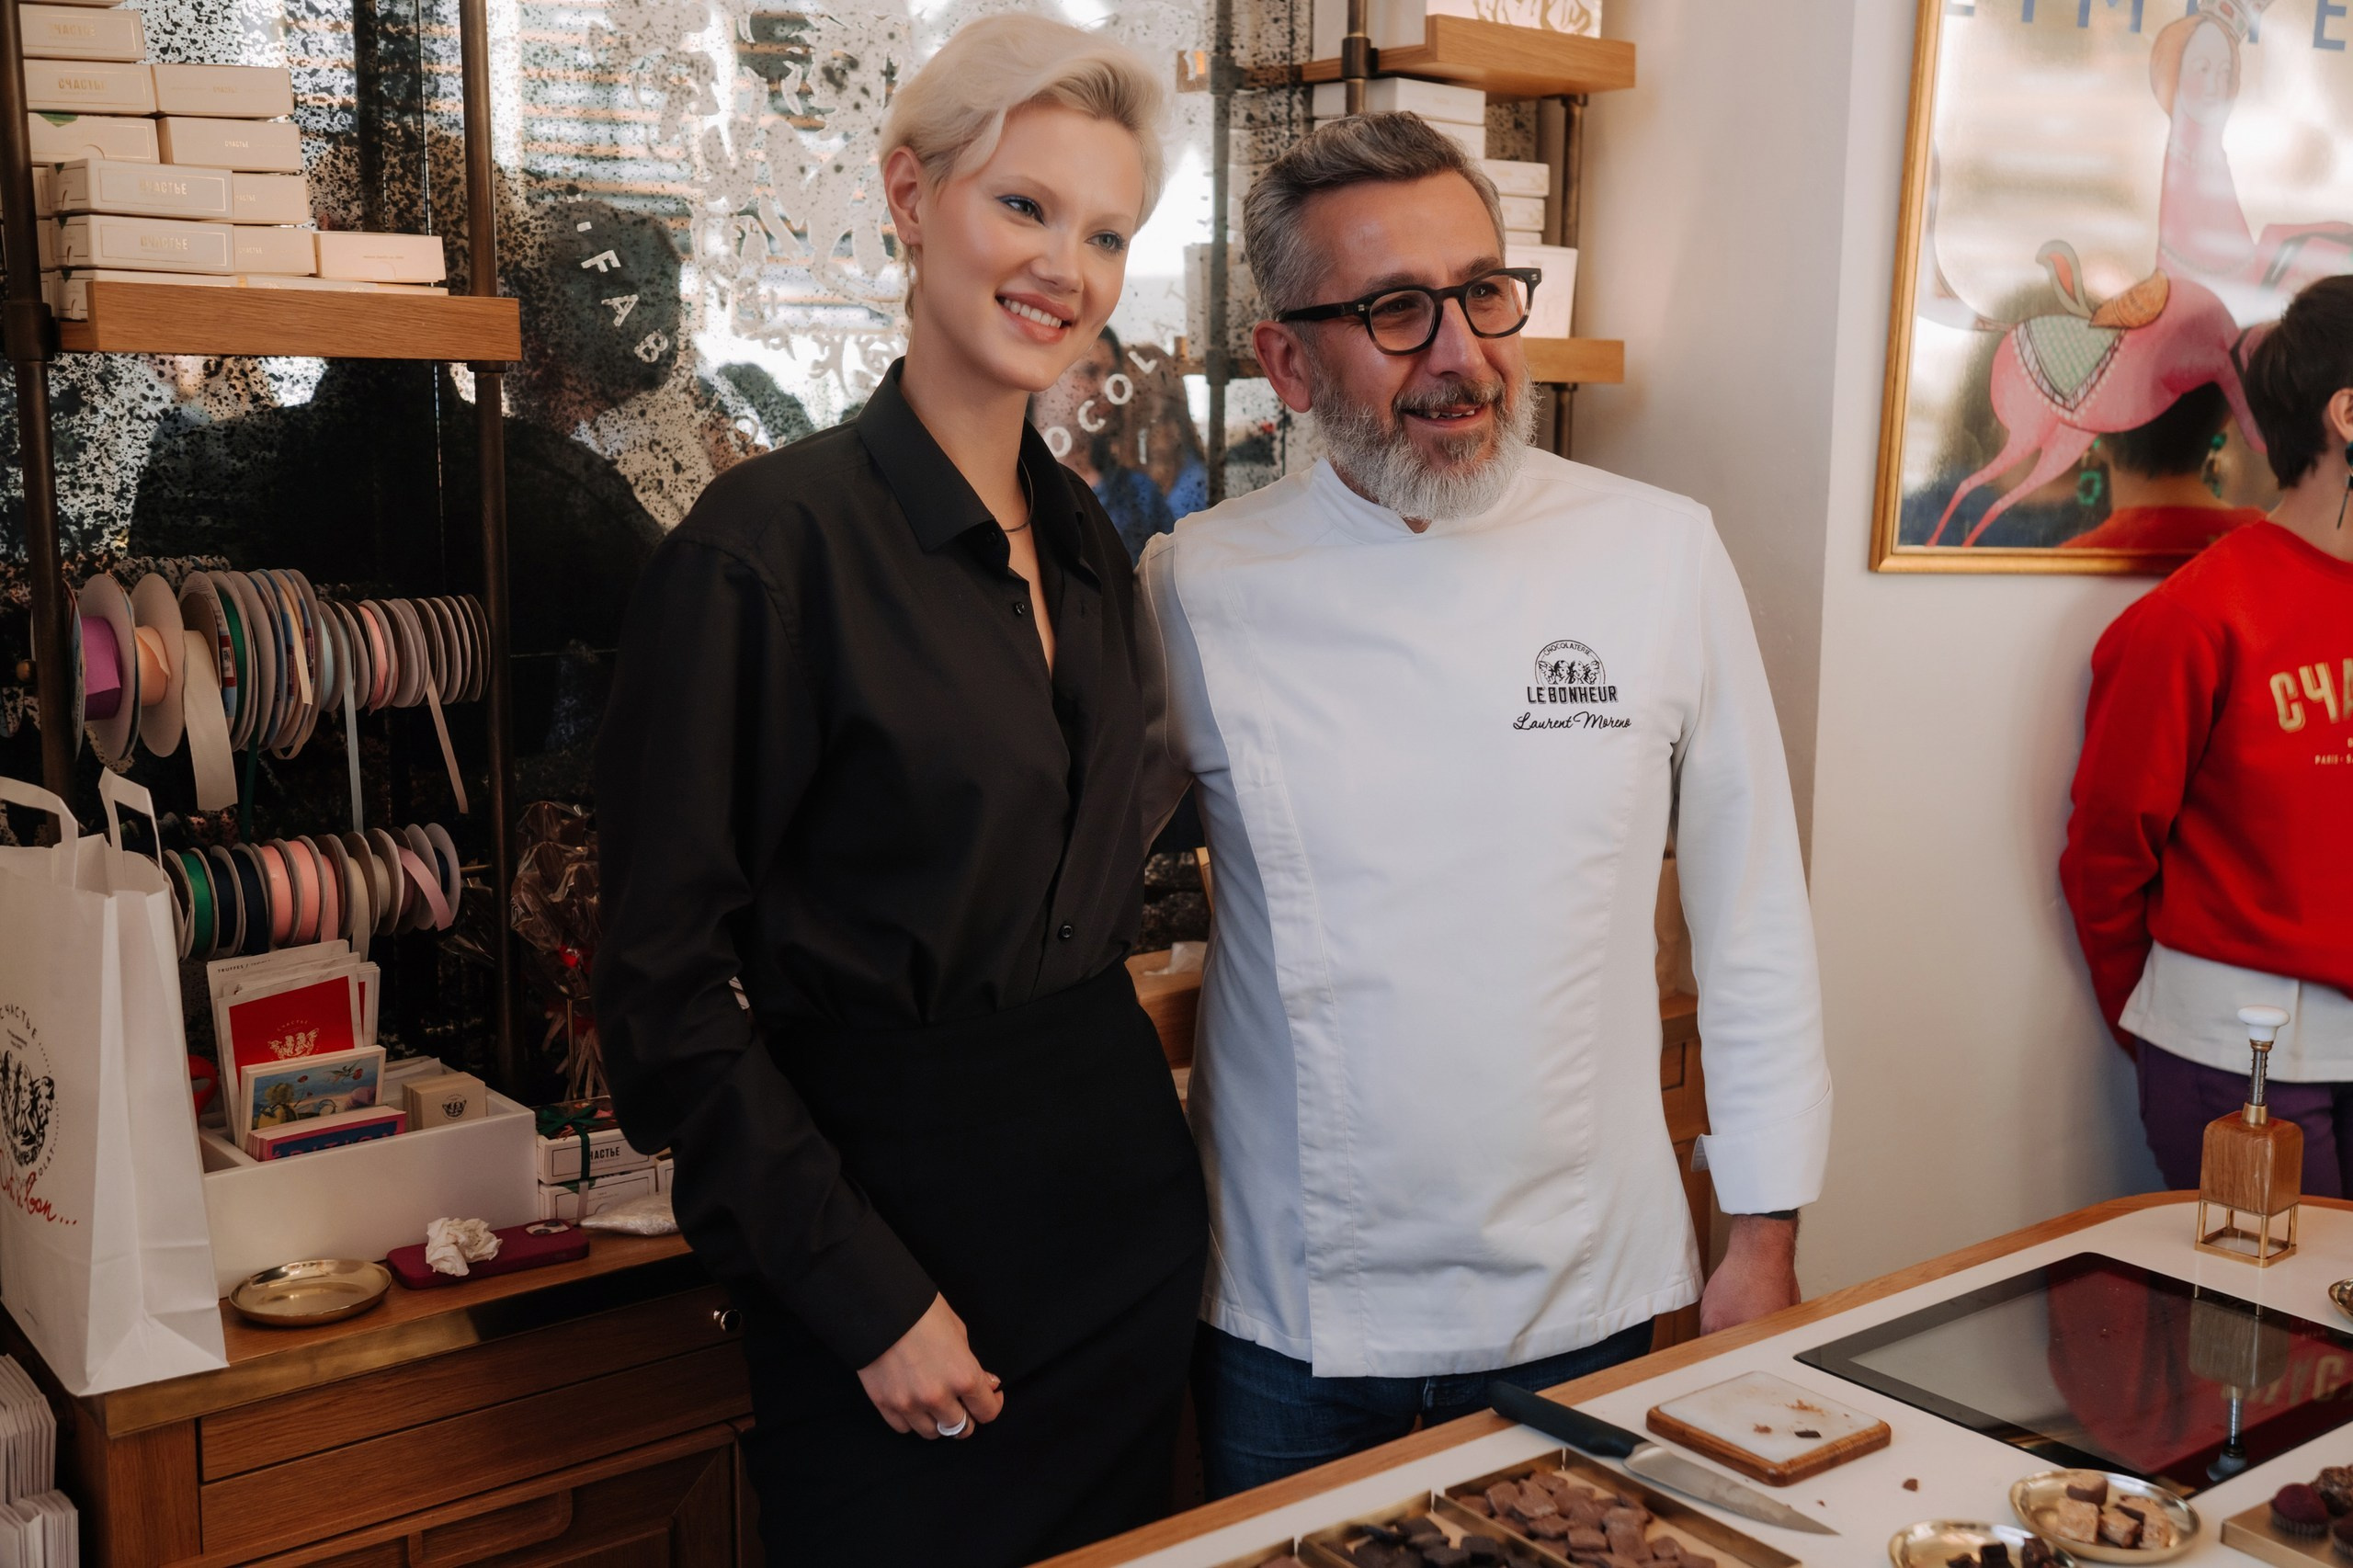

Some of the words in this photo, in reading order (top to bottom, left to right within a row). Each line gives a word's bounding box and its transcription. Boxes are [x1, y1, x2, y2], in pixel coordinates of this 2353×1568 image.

[1543, 642, 1592, 656] CHOCOLATERIE
[1548, 685, 1619, 704] BONHEUR
[1513, 711, 1574, 731] Laurent
[1573, 710, 1632, 730] Moreno
[217, 964, 244, 973] TRUFFES
